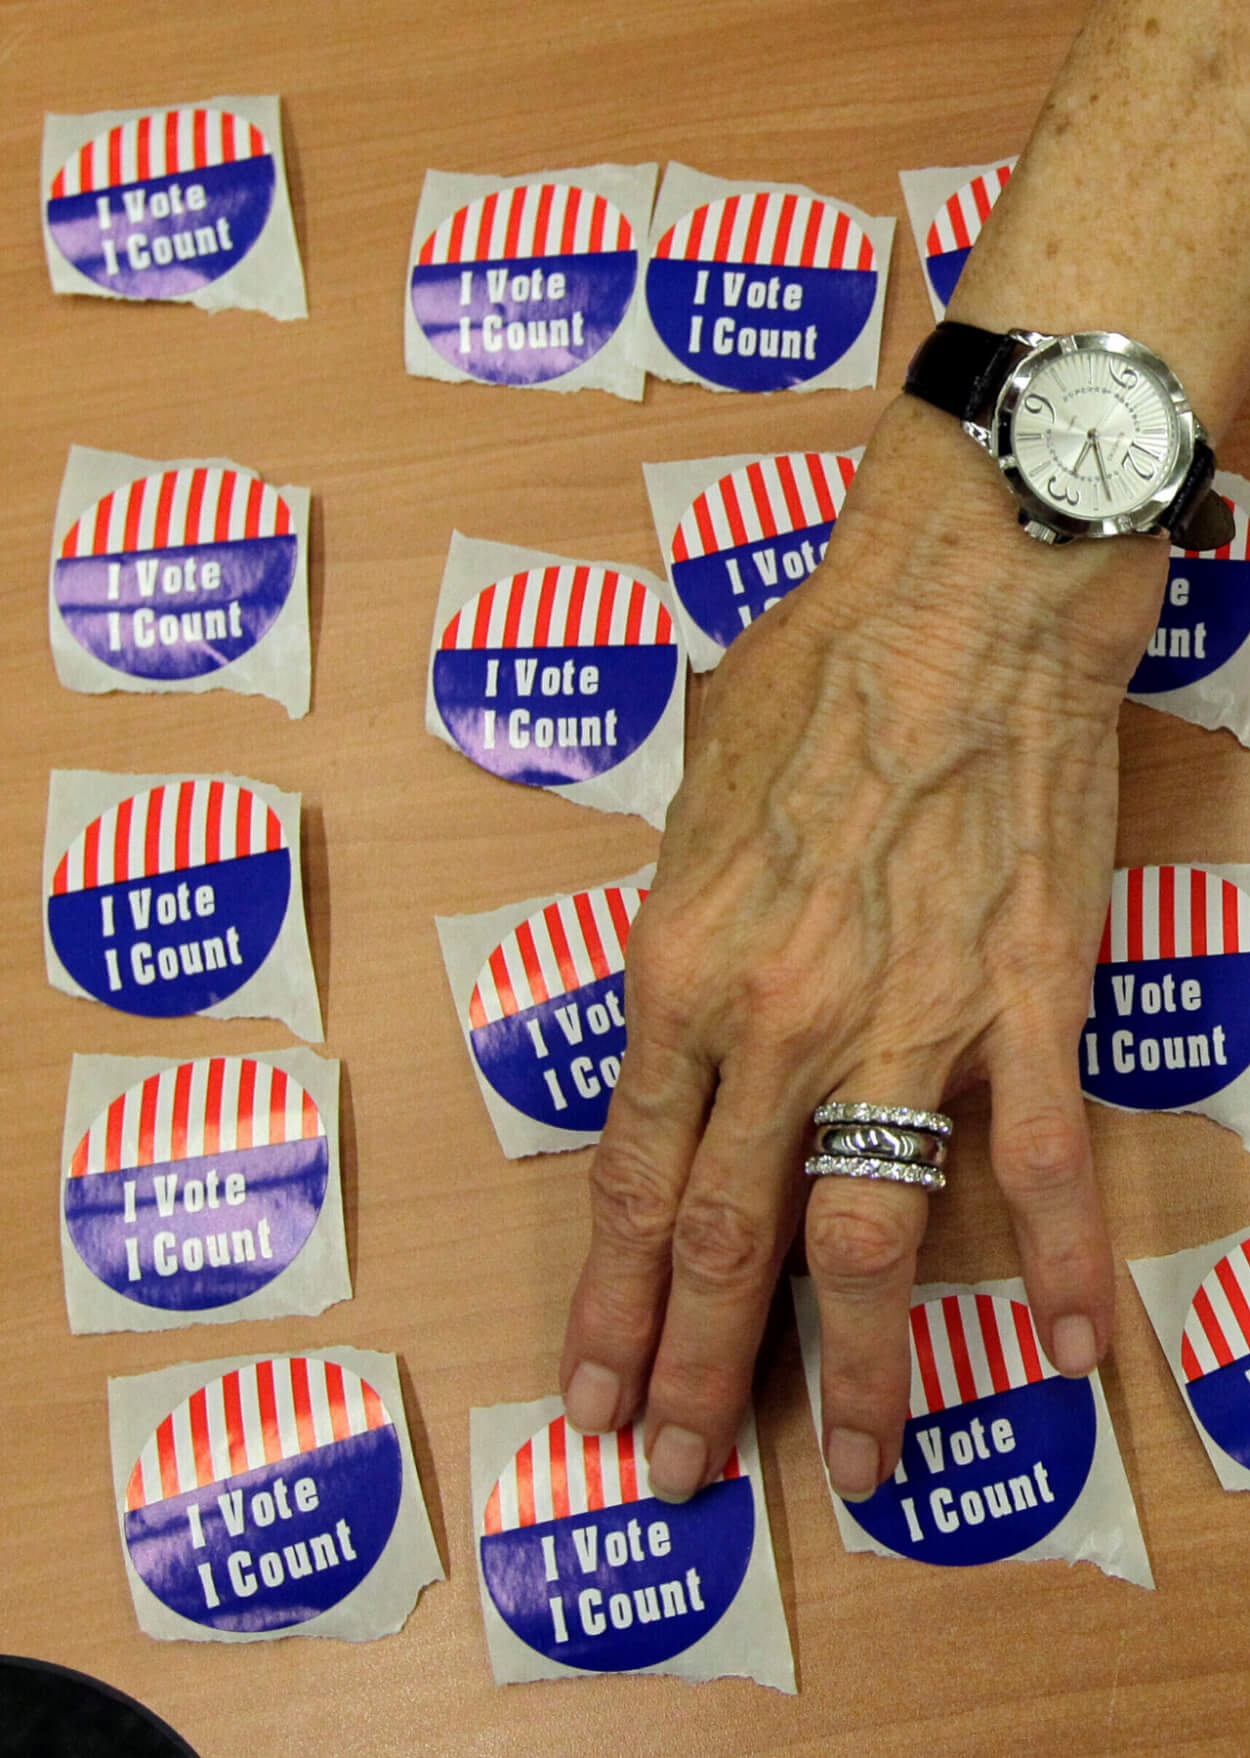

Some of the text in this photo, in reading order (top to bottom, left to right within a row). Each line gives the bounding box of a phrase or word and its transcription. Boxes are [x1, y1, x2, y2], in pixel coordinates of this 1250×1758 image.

[97, 183, 207, 230] I Vote
[102, 216, 234, 276] I Count
[459, 268, 566, 307] I Vote
[693, 270, 803, 311] I Vote
[459, 311, 585, 355] I Count
[689, 316, 818, 361] I Count
[107, 556, 222, 601] I Vote
[725, 558, 745, 595] I
[108, 600, 243, 651] I Count
[1147, 621, 1207, 659] unt
[485, 658, 600, 698] I Vote
[483, 707, 618, 750] I Count
[101, 882, 216, 937] I Vote
[105, 926, 243, 991] I Count
[1111, 973, 1203, 1017] Vote
[526, 990, 626, 1059] I Vot
[1085, 1024, 1228, 1076] I Count
[543, 1068, 568, 1111] I
[123, 1169, 247, 1224] I Vote
[125, 1217, 274, 1282] I Count
[916, 1417, 1016, 1474] Vote
[186, 1477, 320, 1550] I Vote
[901, 1497, 924, 1542] I
[929, 1461, 1055, 1533] Count
[197, 1518, 358, 1609] I Count
[540, 1518, 672, 1582] I Vote
[548, 1567, 705, 1643] I Count
